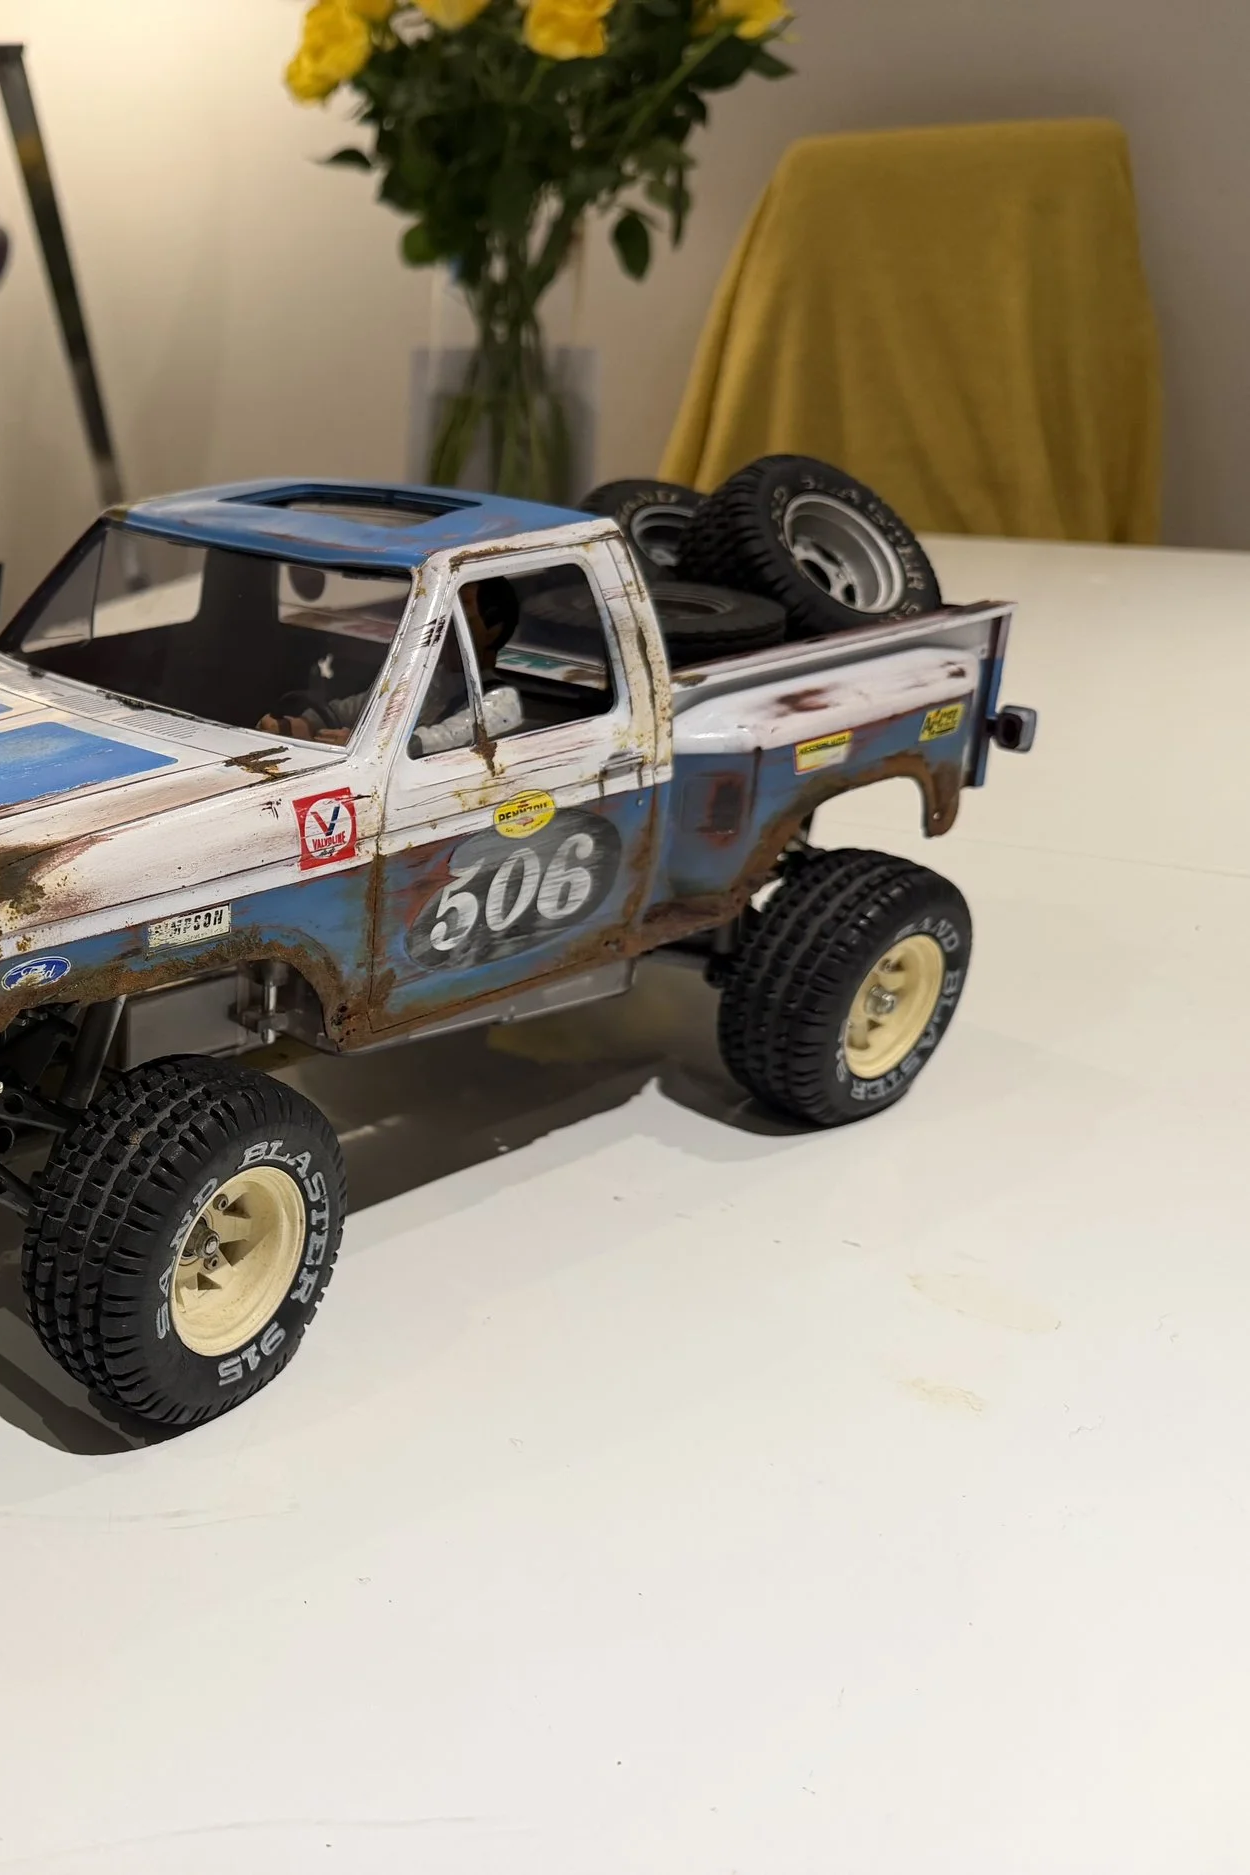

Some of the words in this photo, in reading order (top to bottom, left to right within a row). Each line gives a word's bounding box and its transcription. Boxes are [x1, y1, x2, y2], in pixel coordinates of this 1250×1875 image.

[430, 833, 594, 951] 506
[238, 1139, 330, 1304] BLASTER
[218, 1320, 287, 1387] 915
